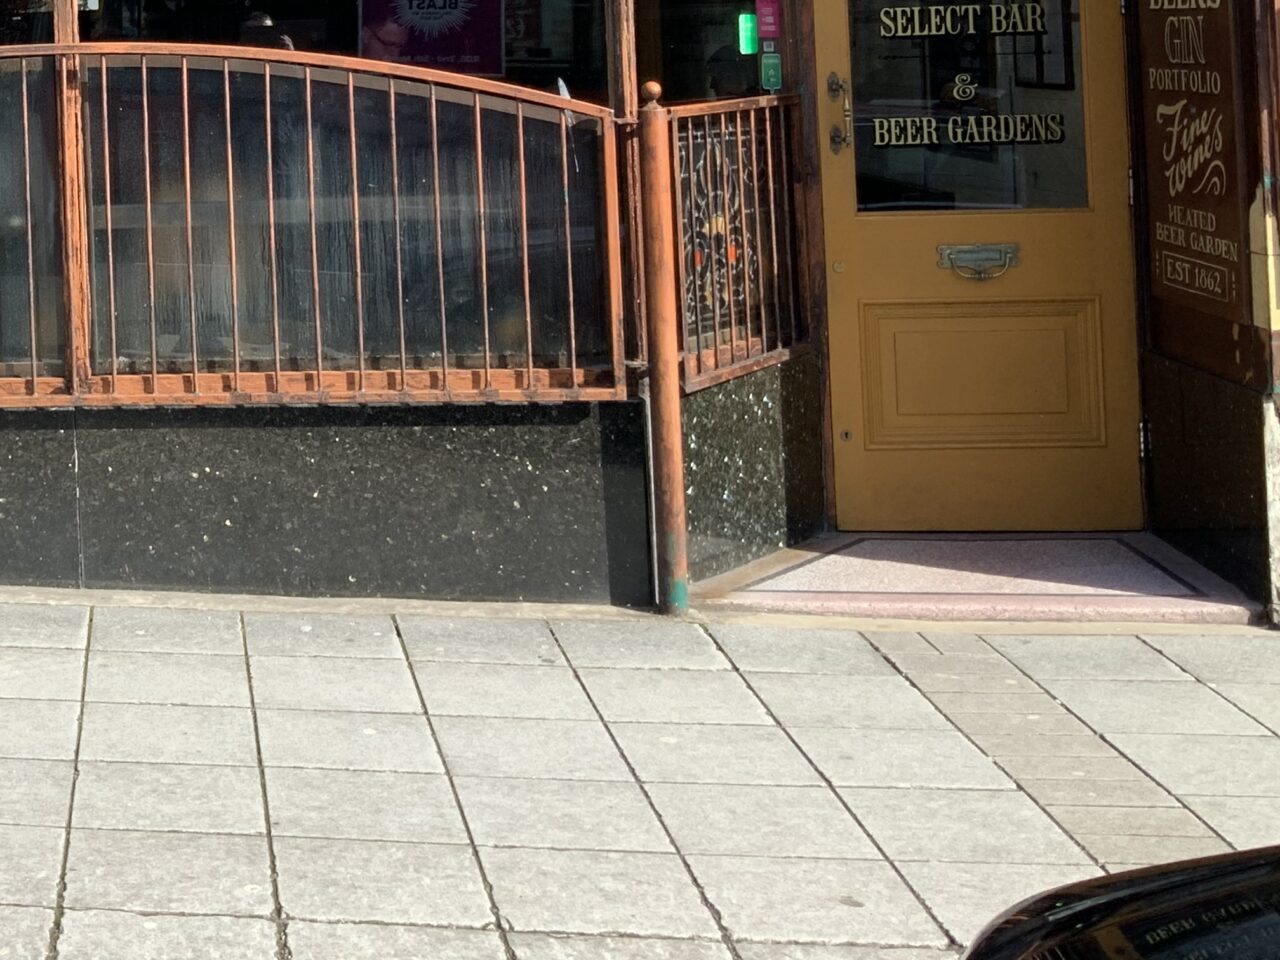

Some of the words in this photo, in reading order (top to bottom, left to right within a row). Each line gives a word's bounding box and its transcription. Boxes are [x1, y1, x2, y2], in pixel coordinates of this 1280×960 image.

[879, 5, 981, 37] SELECT
[989, 2, 1045, 33] BAR
[1164, 15, 1206, 65] GIN
[952, 73, 978, 101] &
[1149, 67, 1221, 95] PORTFOLIO
[873, 117, 939, 146] BEER
[947, 113, 1062, 144] GARDENS
[1156, 99, 1216, 162] Fine
[1168, 203, 1216, 232] HEATED
[1156, 222, 1186, 248] BEER
[1190, 231, 1239, 263] GARDEN
[1166, 258, 1191, 284] EST
[1194, 266, 1222, 294] 1862
